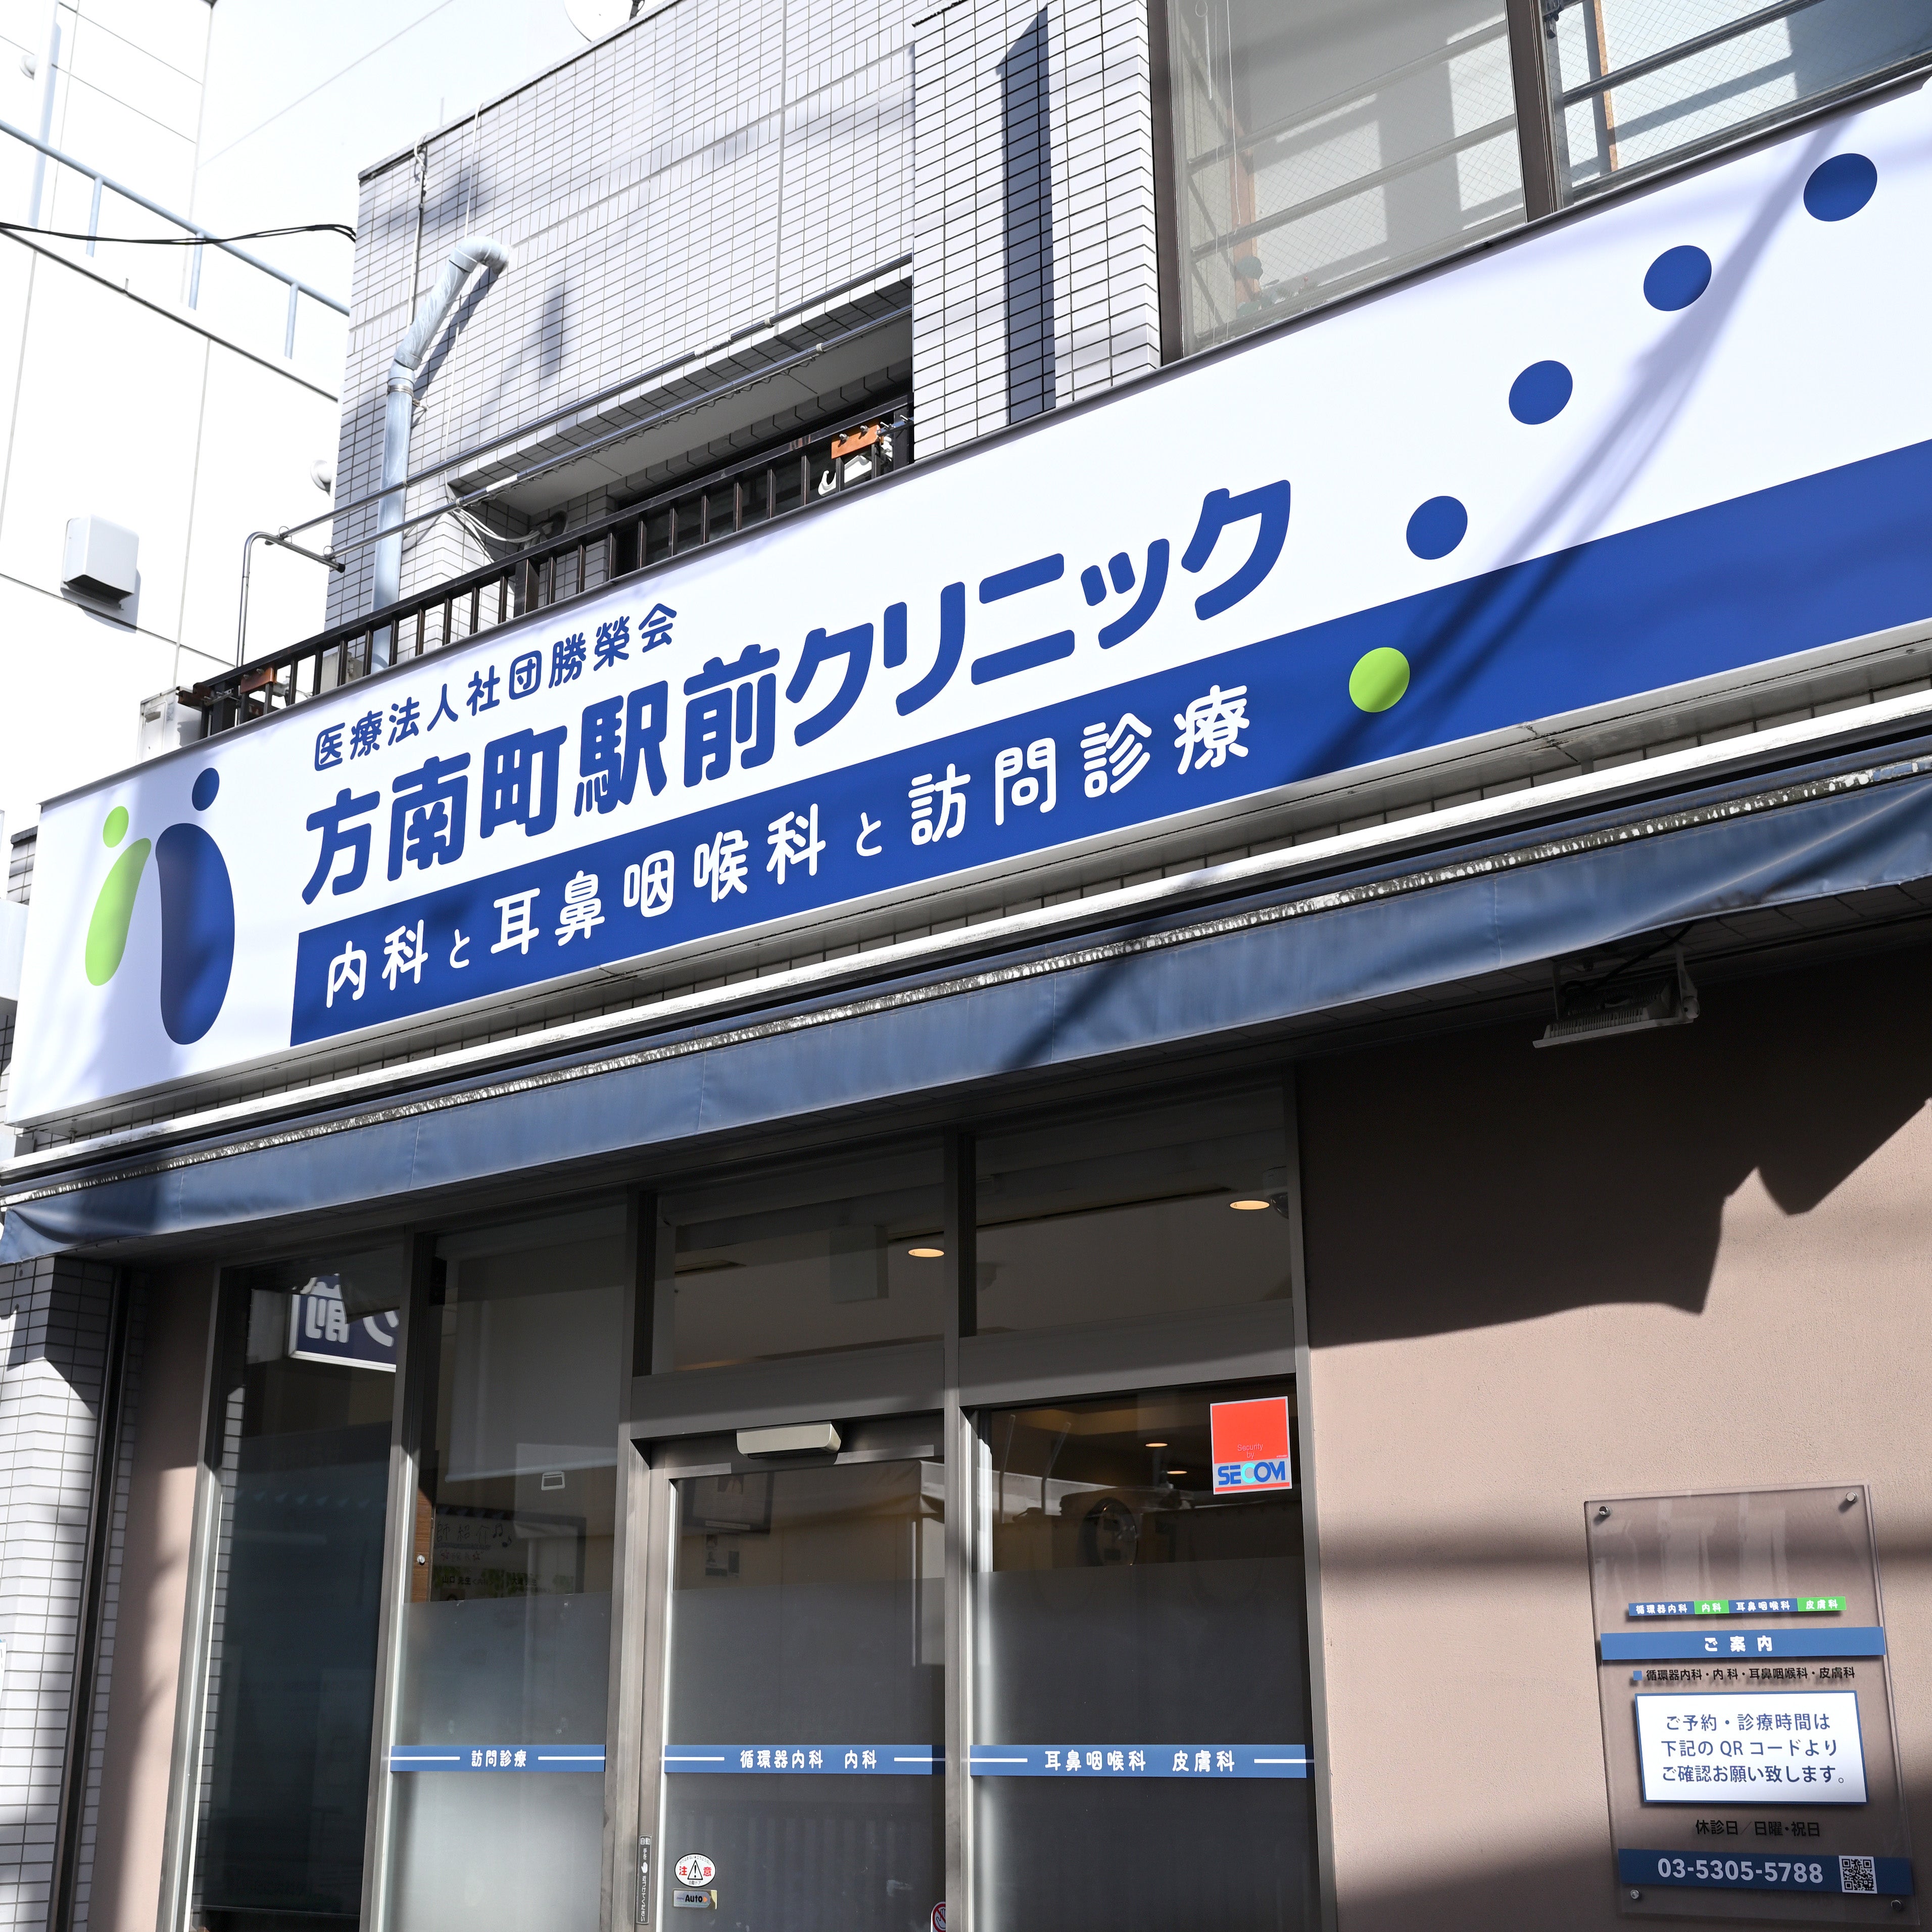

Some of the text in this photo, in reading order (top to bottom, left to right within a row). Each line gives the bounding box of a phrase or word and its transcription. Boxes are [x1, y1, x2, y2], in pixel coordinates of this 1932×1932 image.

[302, 479, 1291, 905] 方南町駅前クリニック
[314, 603, 677, 771] 医療法人社団勝榮会
[1237, 1443, 1264, 1452] Security
[1246, 1451, 1254, 1459] by
[1218, 1461, 1286, 1485] SECOM
[1635, 1599, 1838, 1615] 循環器内科 内科 耳鼻咽喉科 皮膚科
[1666, 1713, 1830, 1731] ご予約・診療時間は
[471, 1749, 527, 1767] 訪問診療
[740, 1749, 877, 1769] 循環器内科 内科
[1044, 1750, 1235, 1773] 耳鼻咽喉科 皮膚科
[1662, 1765, 1845, 1784] ご確認お願い致します。
[1658, 1858, 1823, 1883] 03-5305-5788
[685, 1895, 703, 1903] Auto
